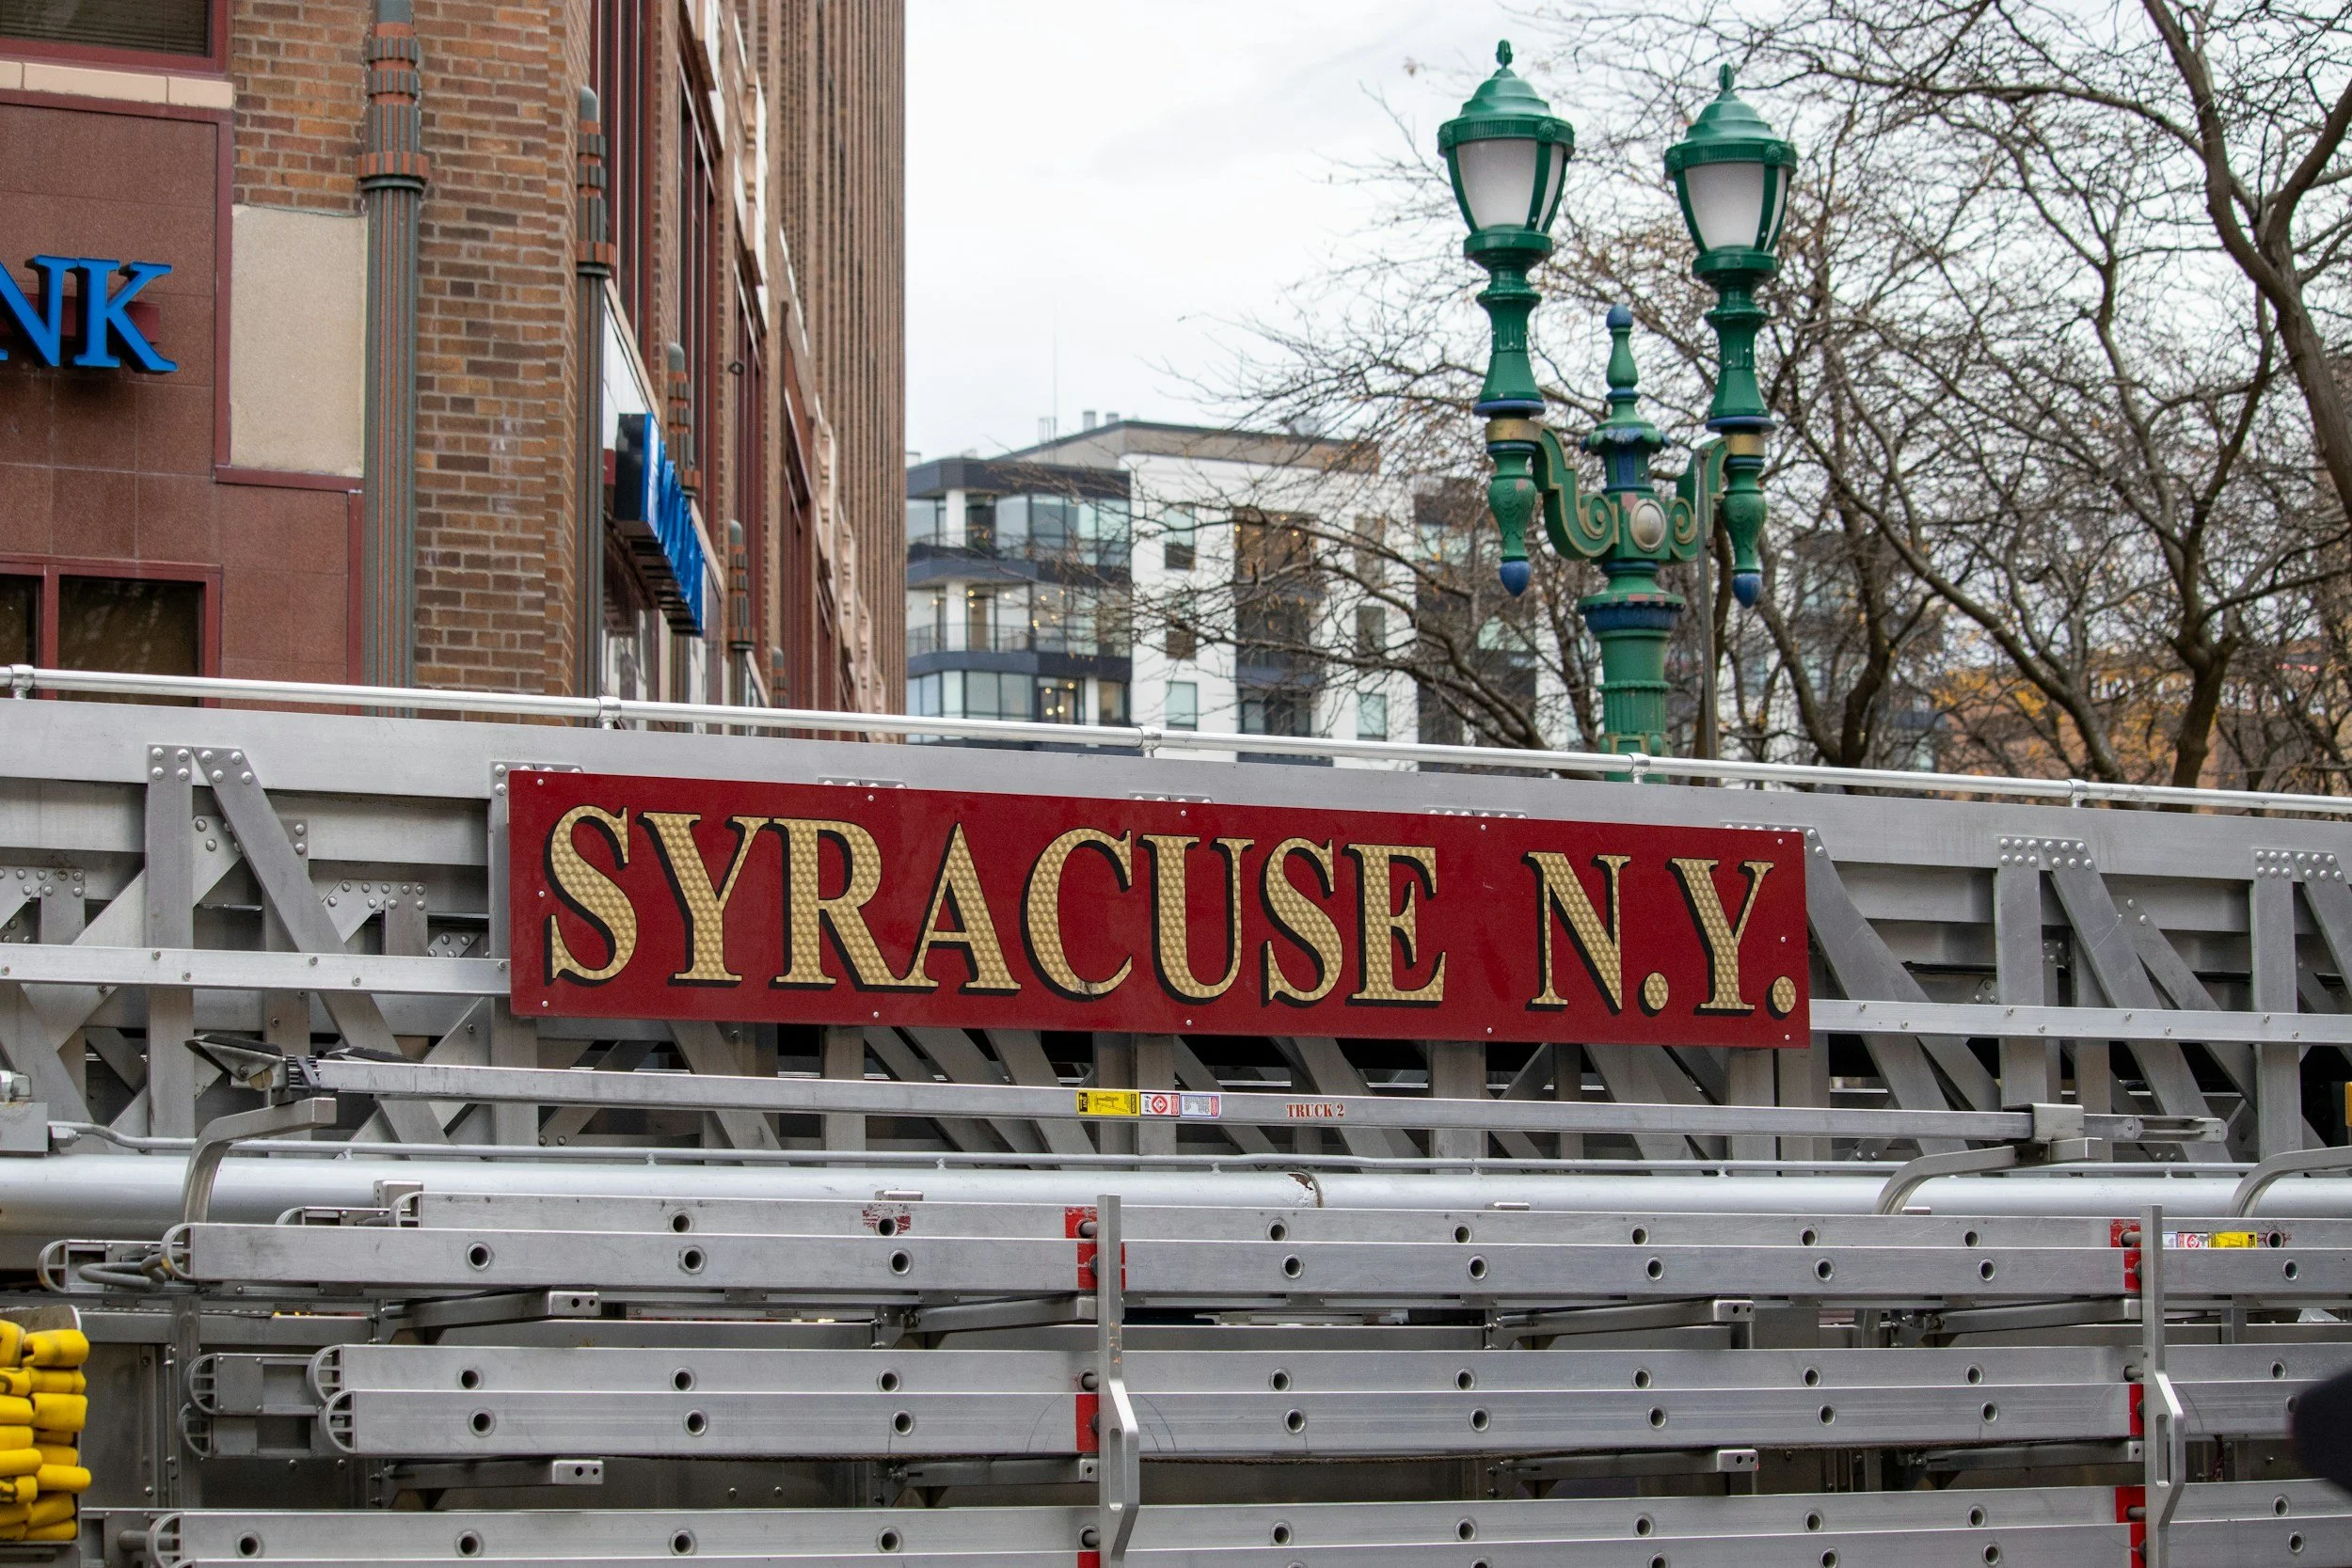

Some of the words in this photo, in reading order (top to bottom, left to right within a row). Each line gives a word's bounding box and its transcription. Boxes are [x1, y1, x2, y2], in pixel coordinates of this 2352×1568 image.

[544, 804, 1447, 1008] SYRACUSE
[1520, 849, 1798, 1022] N.Y.
[1286, 1103, 1333, 1117] TRUCK
[1336, 1103, 1344, 1117] 2
